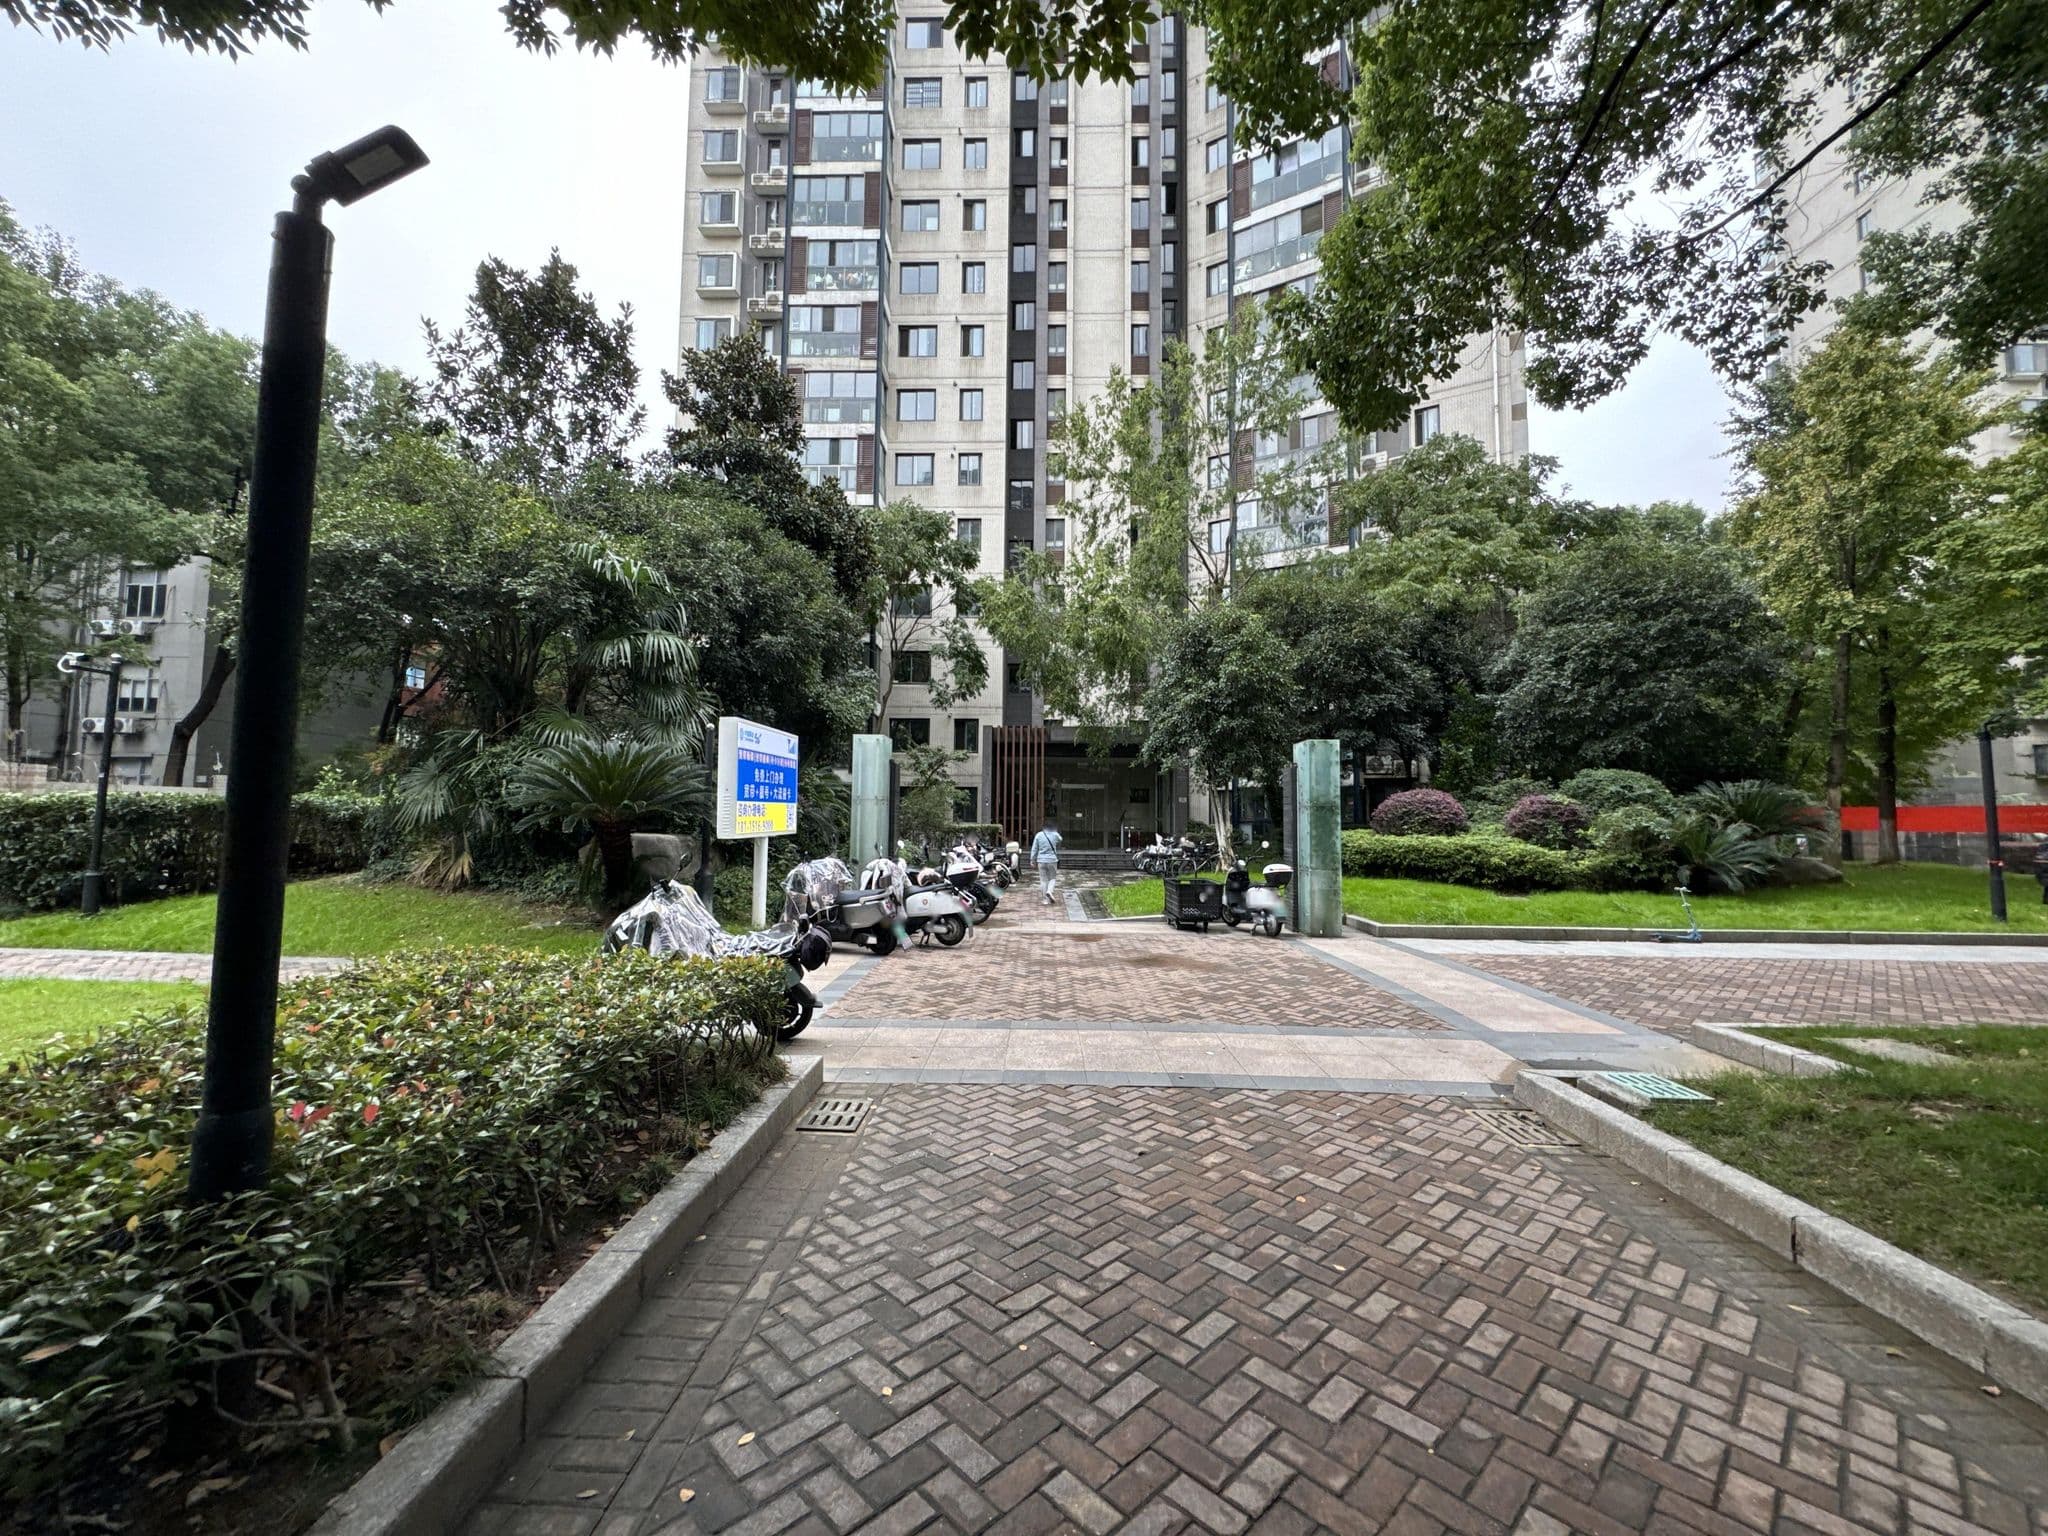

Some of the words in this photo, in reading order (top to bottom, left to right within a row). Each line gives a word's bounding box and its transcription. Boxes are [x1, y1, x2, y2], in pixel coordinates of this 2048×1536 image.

[754, 767, 784, 785] 免费上门办理
